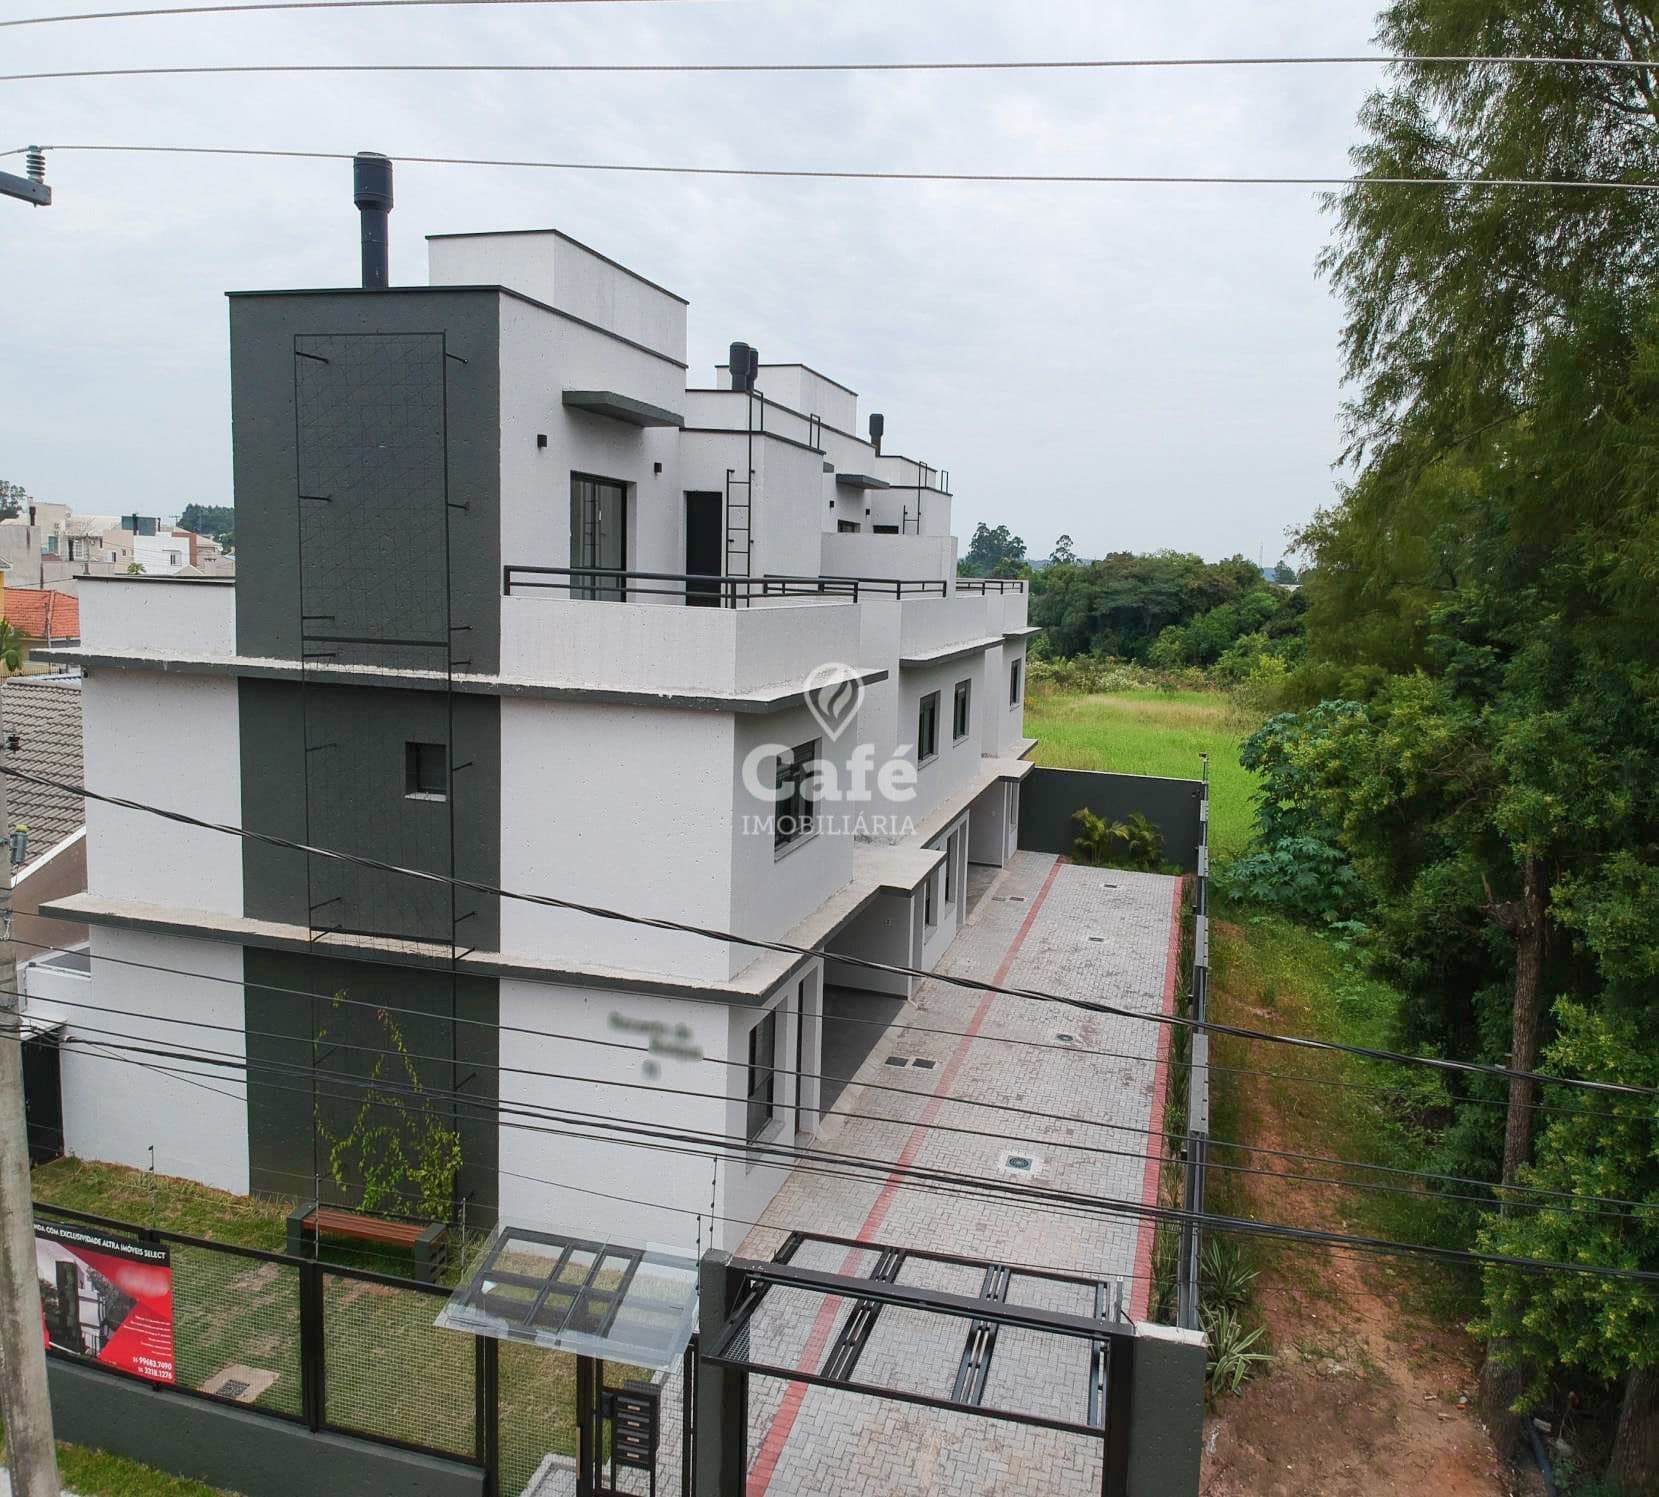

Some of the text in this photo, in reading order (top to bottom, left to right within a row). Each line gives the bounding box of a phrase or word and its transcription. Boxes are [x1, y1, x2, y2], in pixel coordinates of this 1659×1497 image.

[33, 1224, 167, 1260] NDA COM EXCLUSIVIDADE ALTRA IMÓVEIS SELECT
